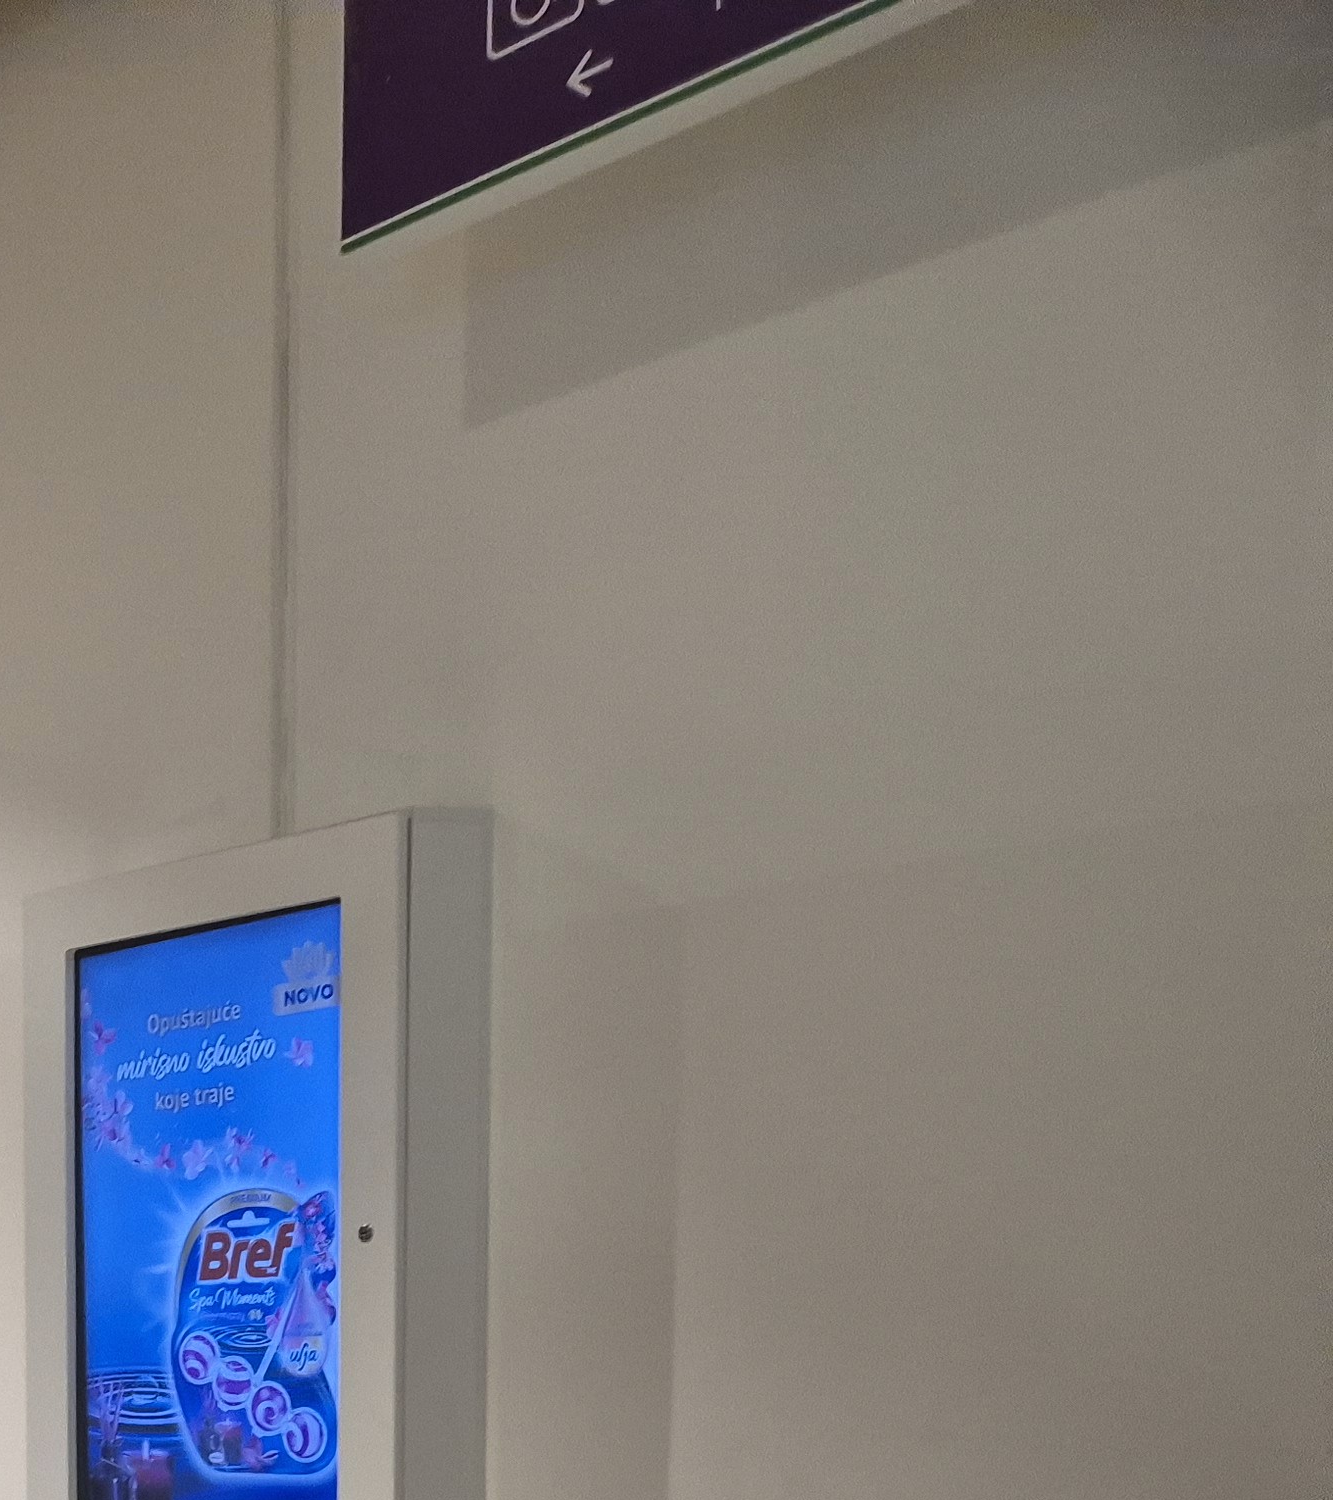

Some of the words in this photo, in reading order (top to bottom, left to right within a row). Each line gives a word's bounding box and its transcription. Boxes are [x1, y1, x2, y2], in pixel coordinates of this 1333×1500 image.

[283, 983, 334, 1008] NOVO
[147, 1000, 242, 1037] Opuštajuće
[116, 1046, 190, 1082] mirisno
[196, 1028, 277, 1074] iskustvo
[155, 1091, 190, 1114] koje
[194, 1081, 236, 1108] traje
[198, 1221, 296, 1281] Bref
[188, 1286, 215, 1313] Spa
